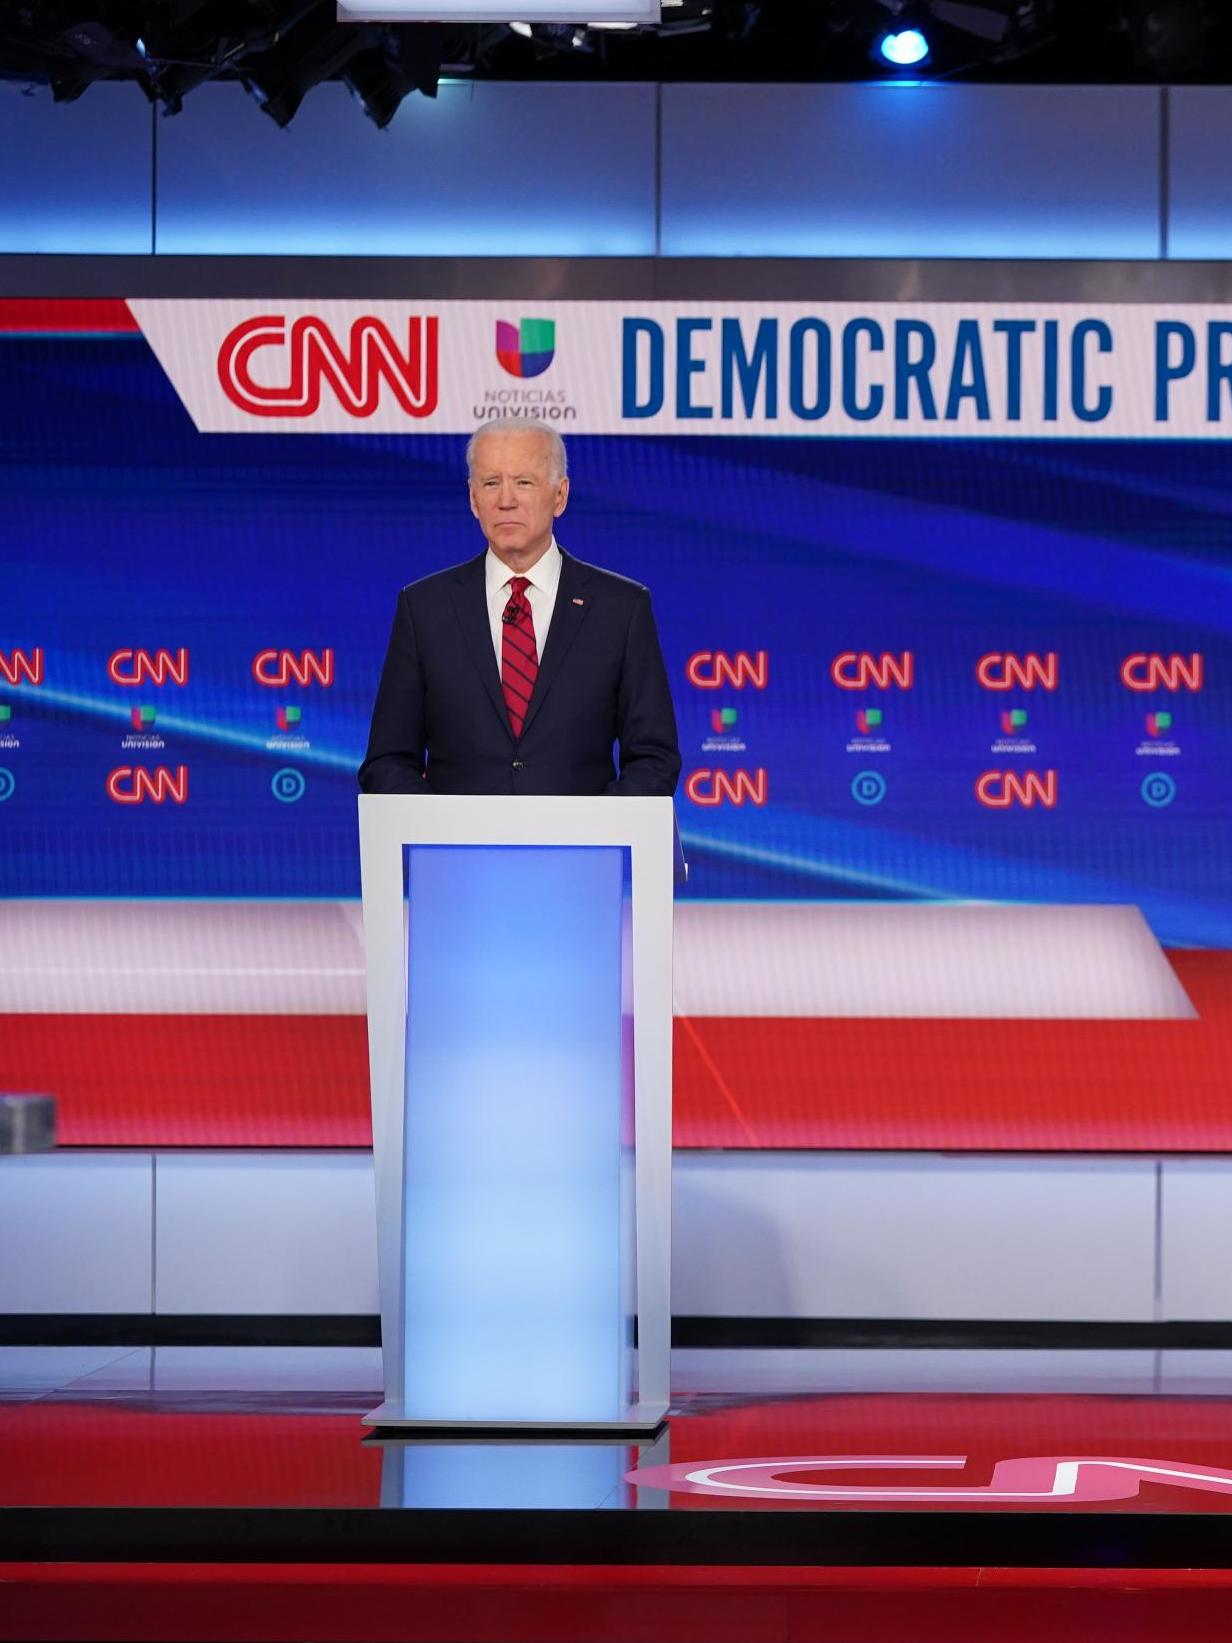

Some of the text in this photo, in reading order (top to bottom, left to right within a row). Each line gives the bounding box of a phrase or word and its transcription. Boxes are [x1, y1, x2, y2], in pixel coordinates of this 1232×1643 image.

[216, 314, 440, 419] CNN
[622, 317, 1113, 422] DEMOCRATIC
[484, 389, 566, 403] NOTICIAS
[0, 648, 44, 686] NN
[108, 649, 188, 685] CNN
[253, 649, 333, 686] CNN
[686, 651, 767, 688] CNN
[831, 652, 913, 689] CNN
[977, 653, 1057, 690] CNN
[1121, 653, 1202, 691] CNN
[107, 765, 188, 803] CNN
[685, 769, 767, 806] CNN
[975, 770, 1057, 807] CNN
